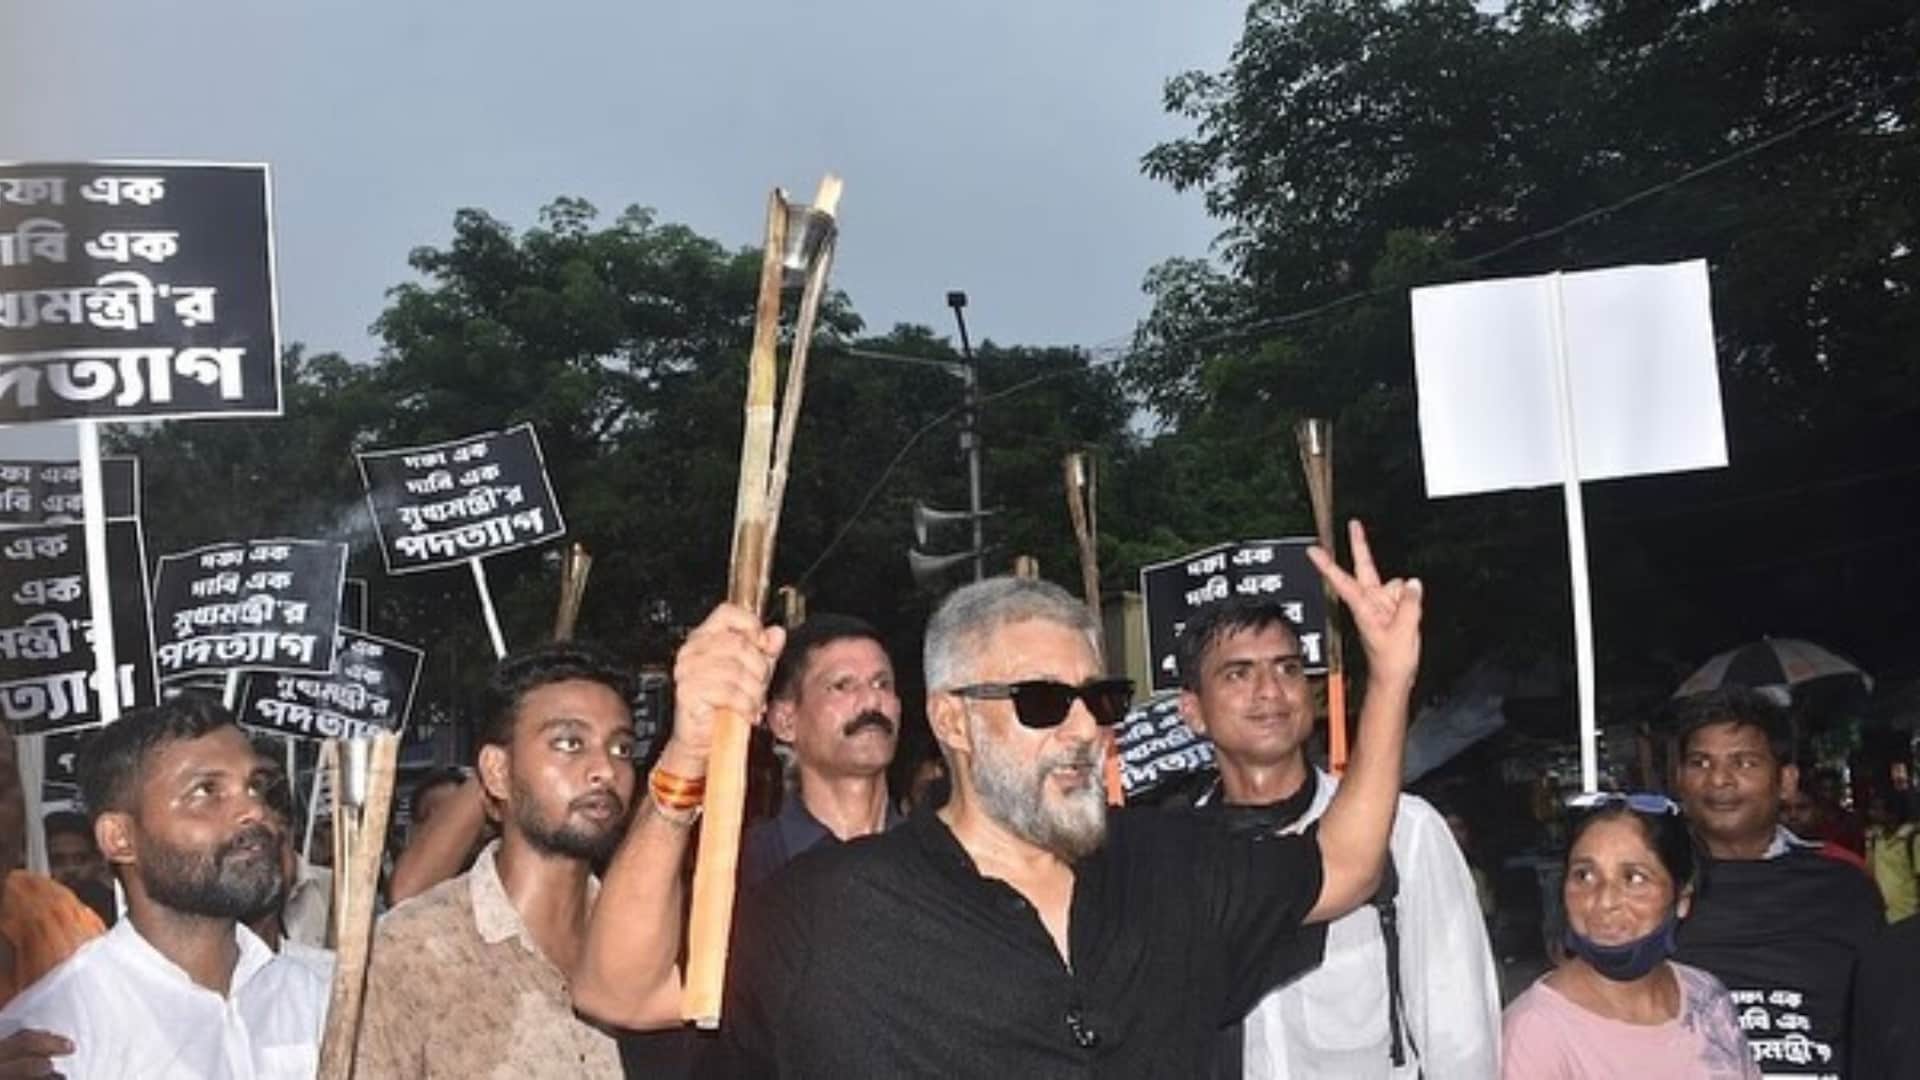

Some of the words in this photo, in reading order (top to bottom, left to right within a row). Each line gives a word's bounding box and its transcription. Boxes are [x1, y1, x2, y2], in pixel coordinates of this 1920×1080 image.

[0, 177, 66, 204] ফা
[80, 177, 166, 205] এক
[0, 218, 68, 265] াবি
[85, 230, 179, 262] এক
[453, 442, 488, 462] এক
[459, 463, 500, 486] এক
[248, 546, 291, 561] এক
[1232, 548, 1274, 565] এক
[246, 571, 294, 590] এক
[1236, 574, 1282, 595] এক
